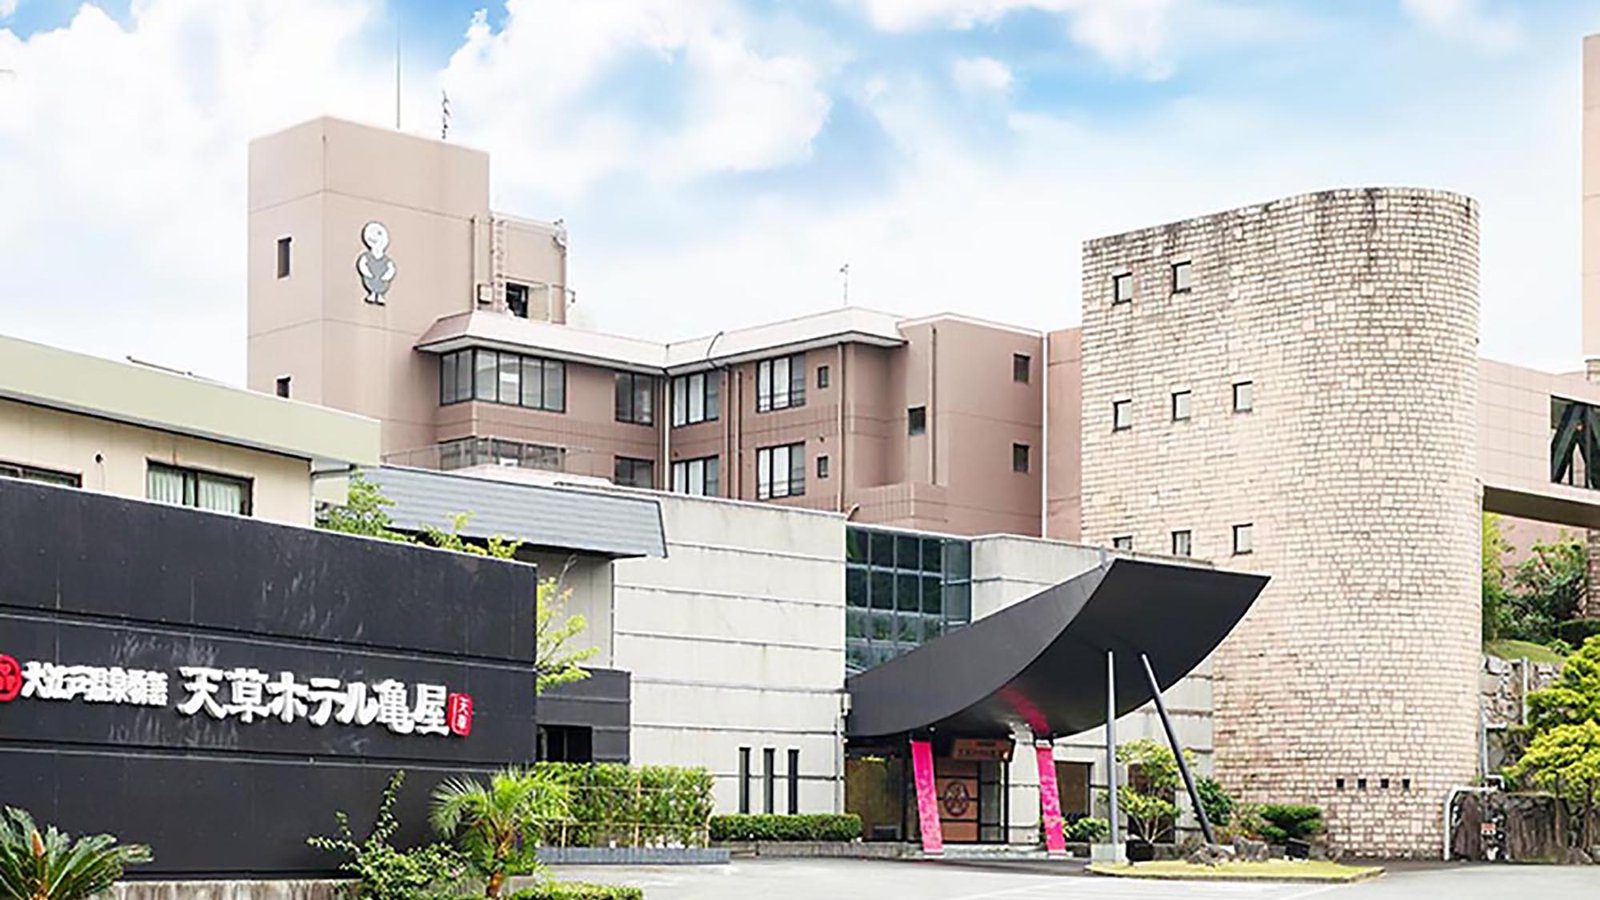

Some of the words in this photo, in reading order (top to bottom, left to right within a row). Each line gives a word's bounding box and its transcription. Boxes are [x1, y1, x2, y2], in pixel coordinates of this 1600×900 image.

[176, 666, 449, 736] 天草ホテル亀屋
